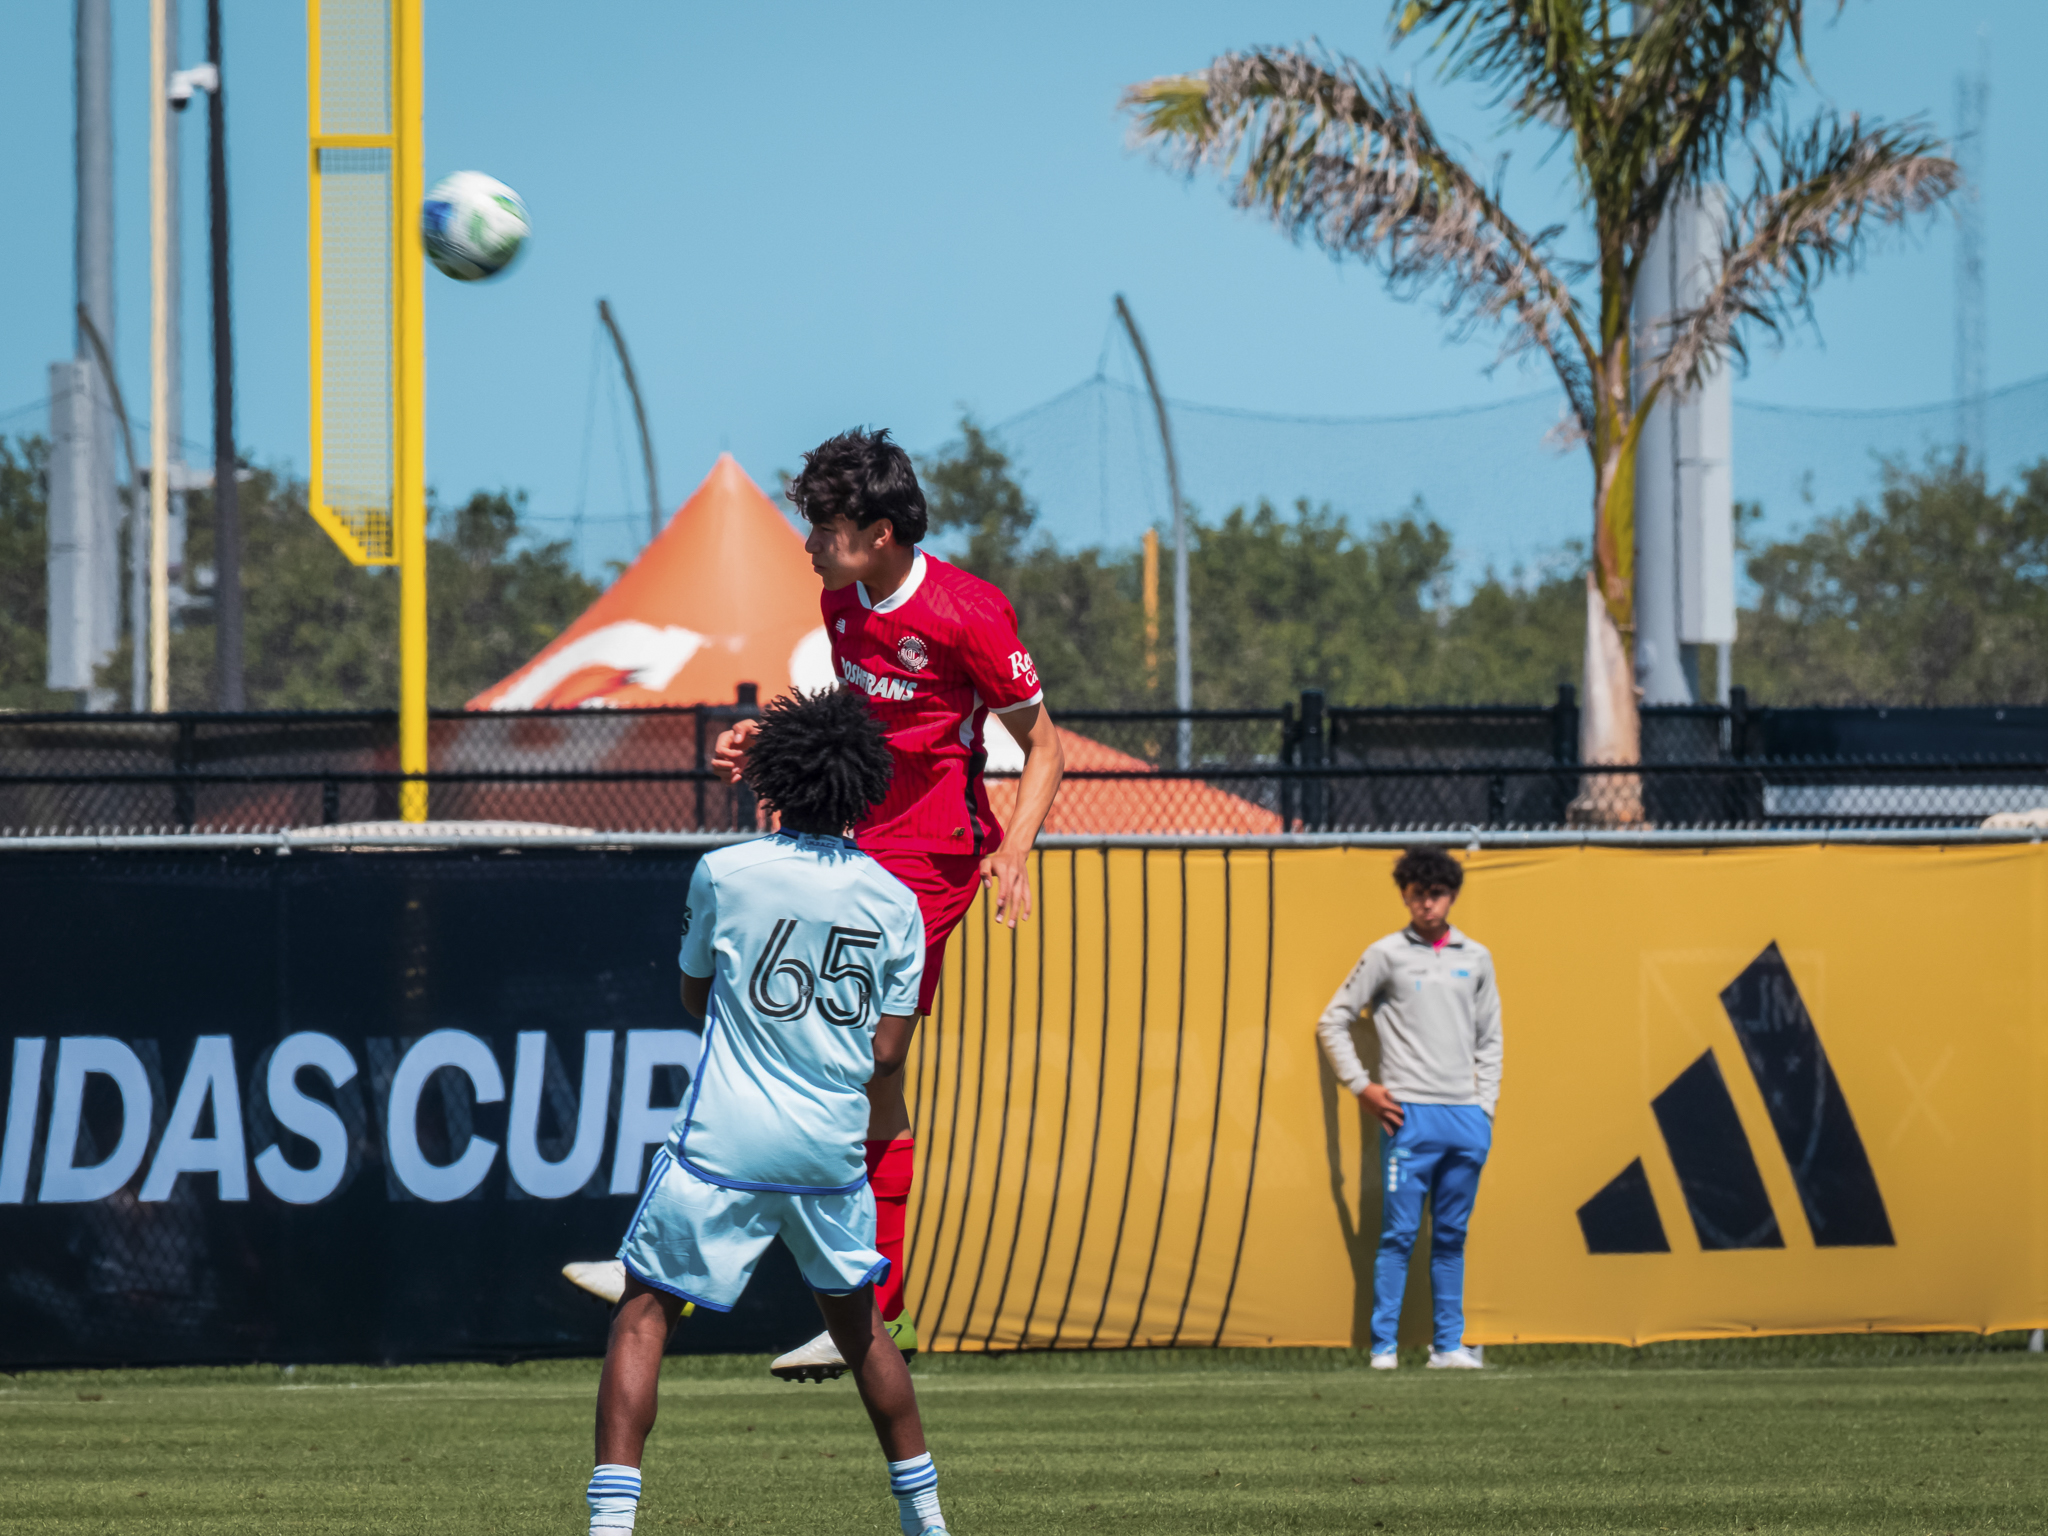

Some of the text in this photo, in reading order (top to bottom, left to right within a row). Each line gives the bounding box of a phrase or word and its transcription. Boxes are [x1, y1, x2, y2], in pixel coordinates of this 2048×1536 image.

[749, 918, 882, 1029] 65
[0, 1028, 702, 1205] IDAS CUP
